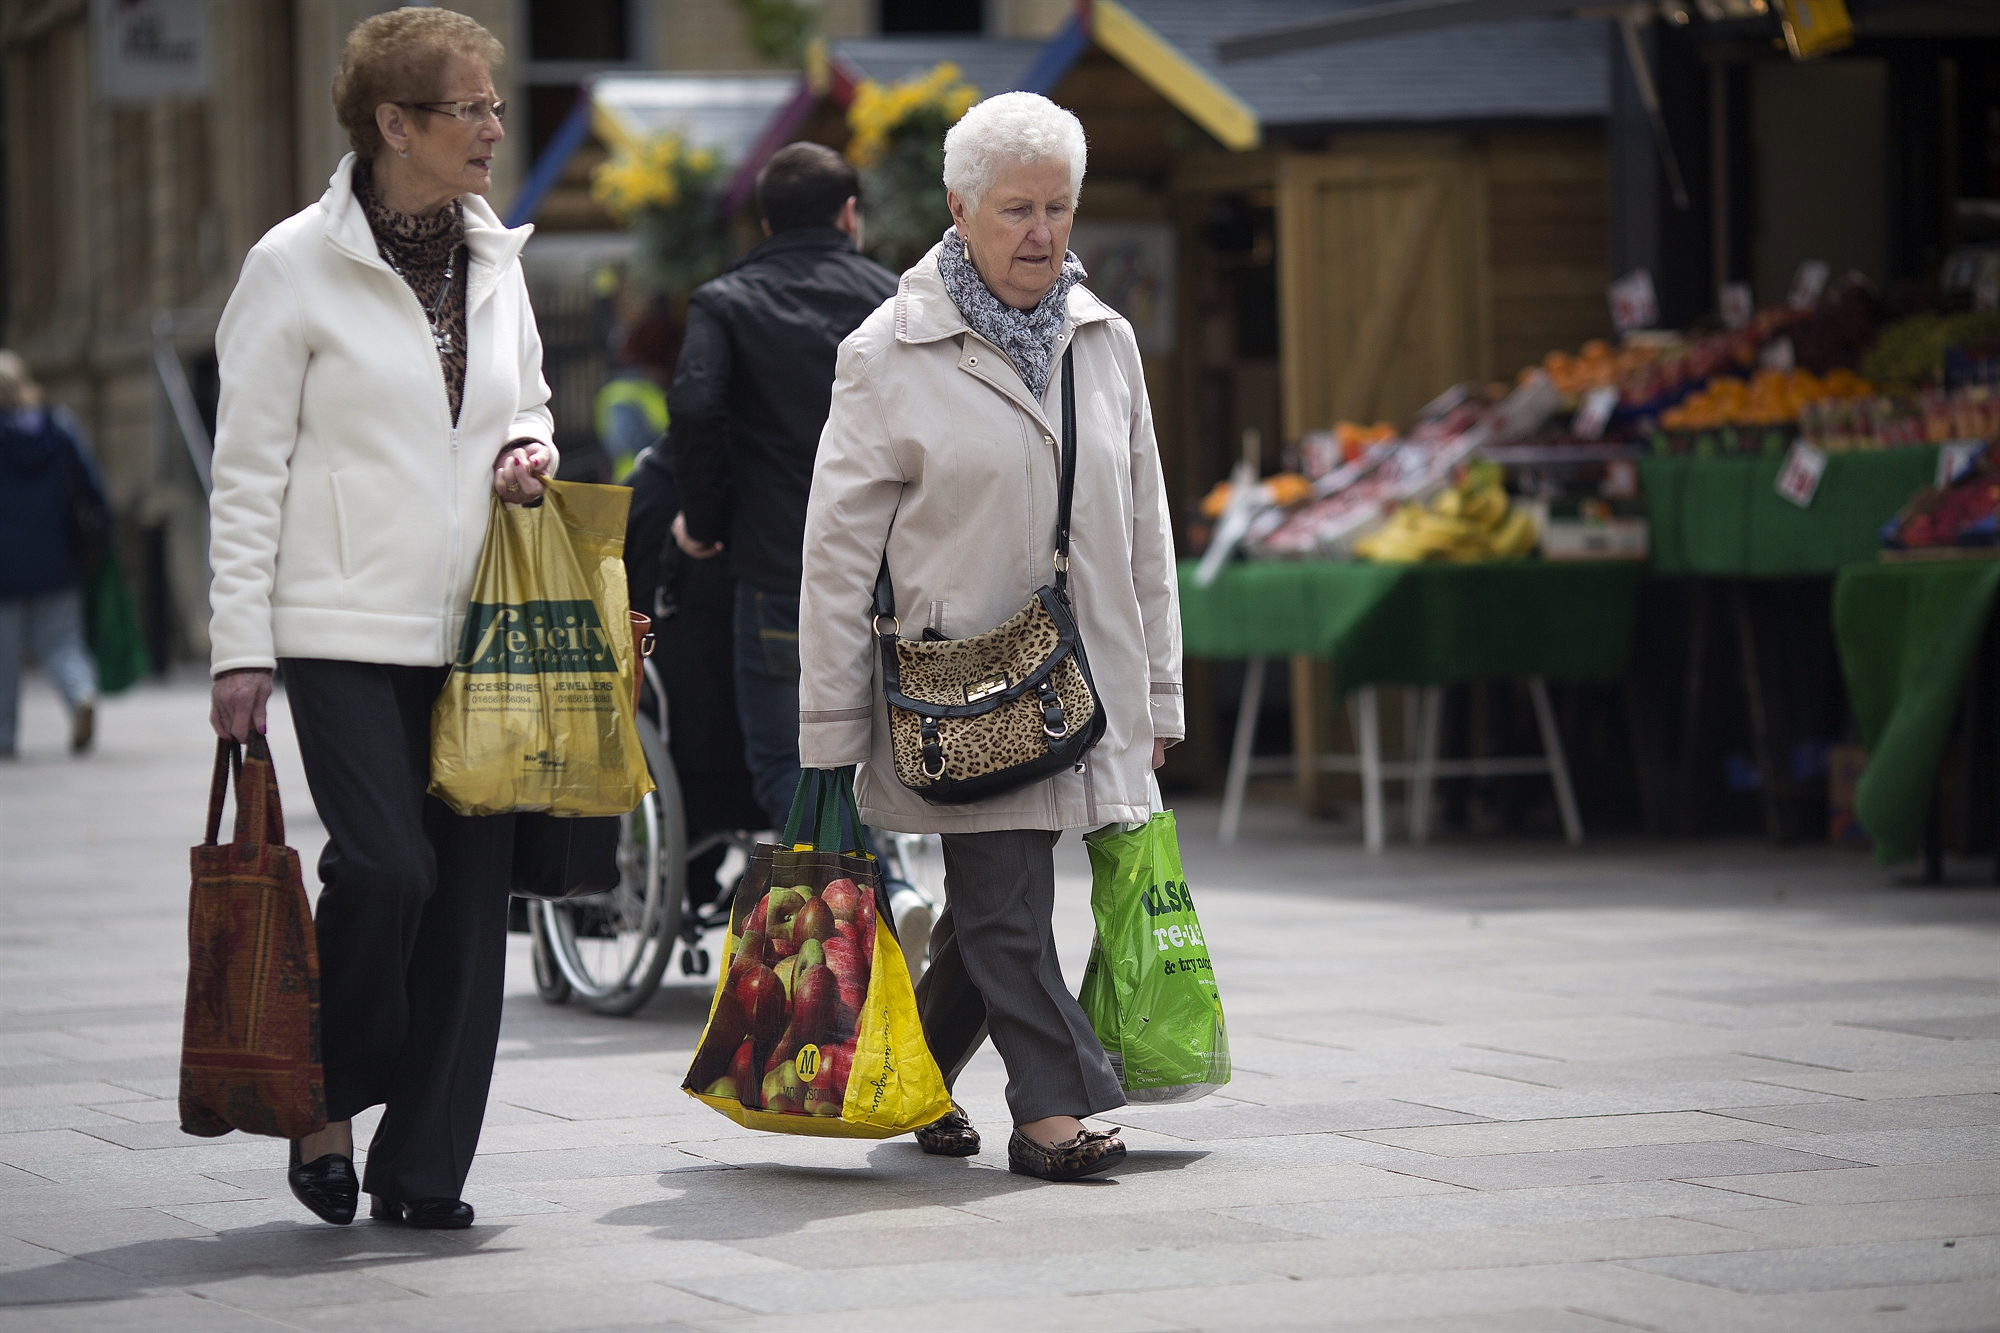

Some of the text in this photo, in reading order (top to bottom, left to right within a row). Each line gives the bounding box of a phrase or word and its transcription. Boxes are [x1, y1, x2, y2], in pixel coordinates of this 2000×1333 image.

[486, 652, 505, 664] of
[463, 681, 542, 693] ACCESSORIES
[553, 681, 613, 692] JEWELLERS
[1164, 960, 1176, 975] &
[1178, 958, 1197, 973] try
[799, 1050, 817, 1075] M
